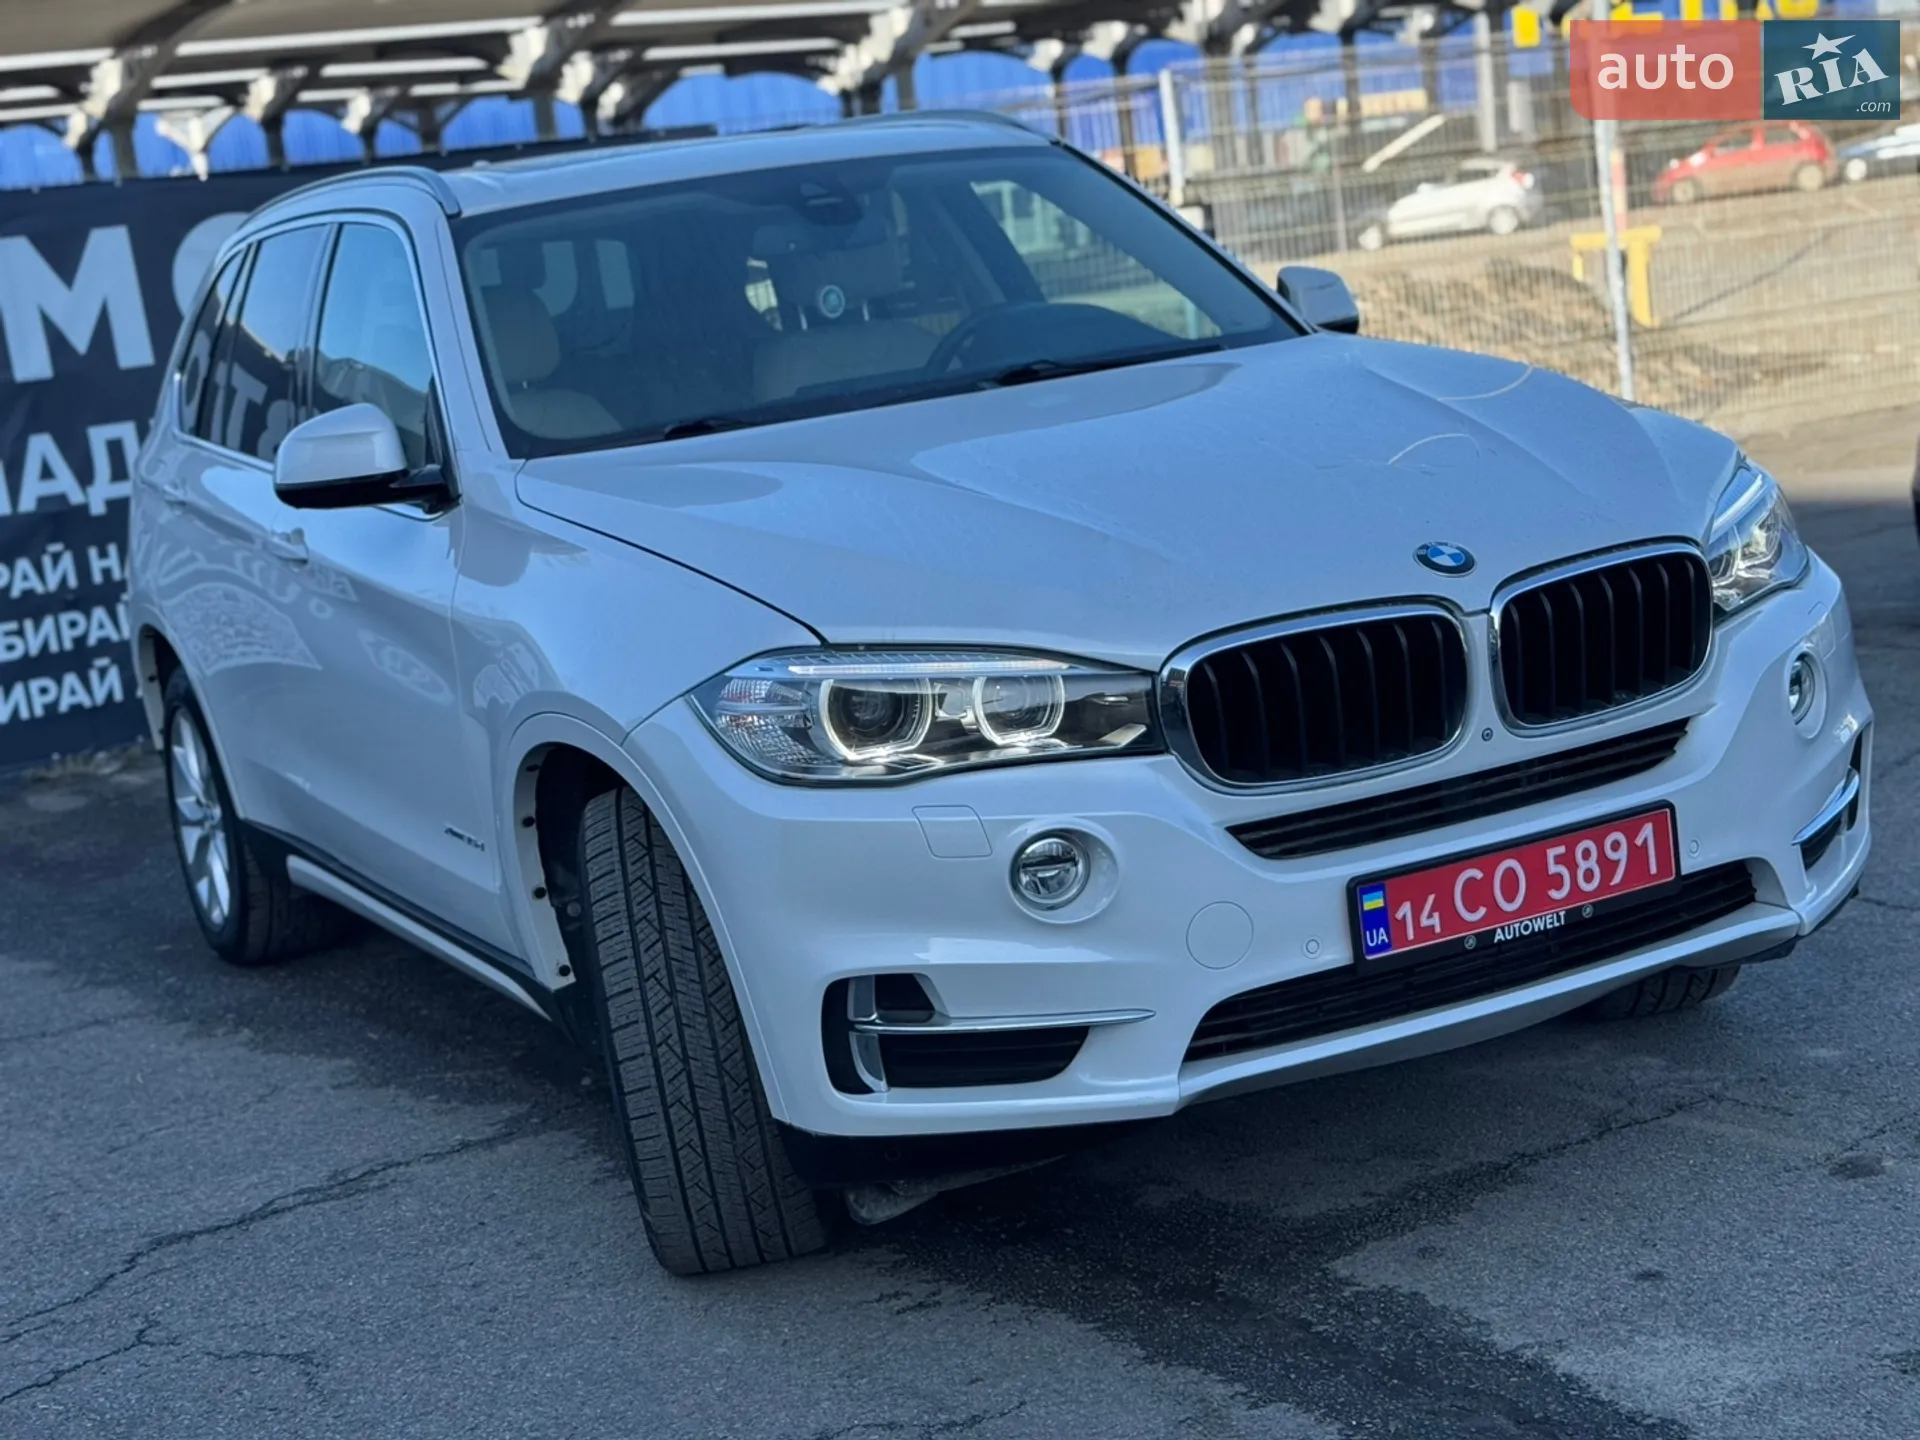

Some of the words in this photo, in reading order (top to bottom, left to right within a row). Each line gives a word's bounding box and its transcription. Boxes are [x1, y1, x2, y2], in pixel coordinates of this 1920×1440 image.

[0, 420, 152, 517] АД
[86, 543, 130, 585] Н
[1395, 894, 1441, 941] 14
[1454, 858, 1527, 923] CO
[1546, 821, 1658, 901] 5891
[1366, 927, 1389, 947] UA
[1493, 910, 1567, 944] AUTOWELT
